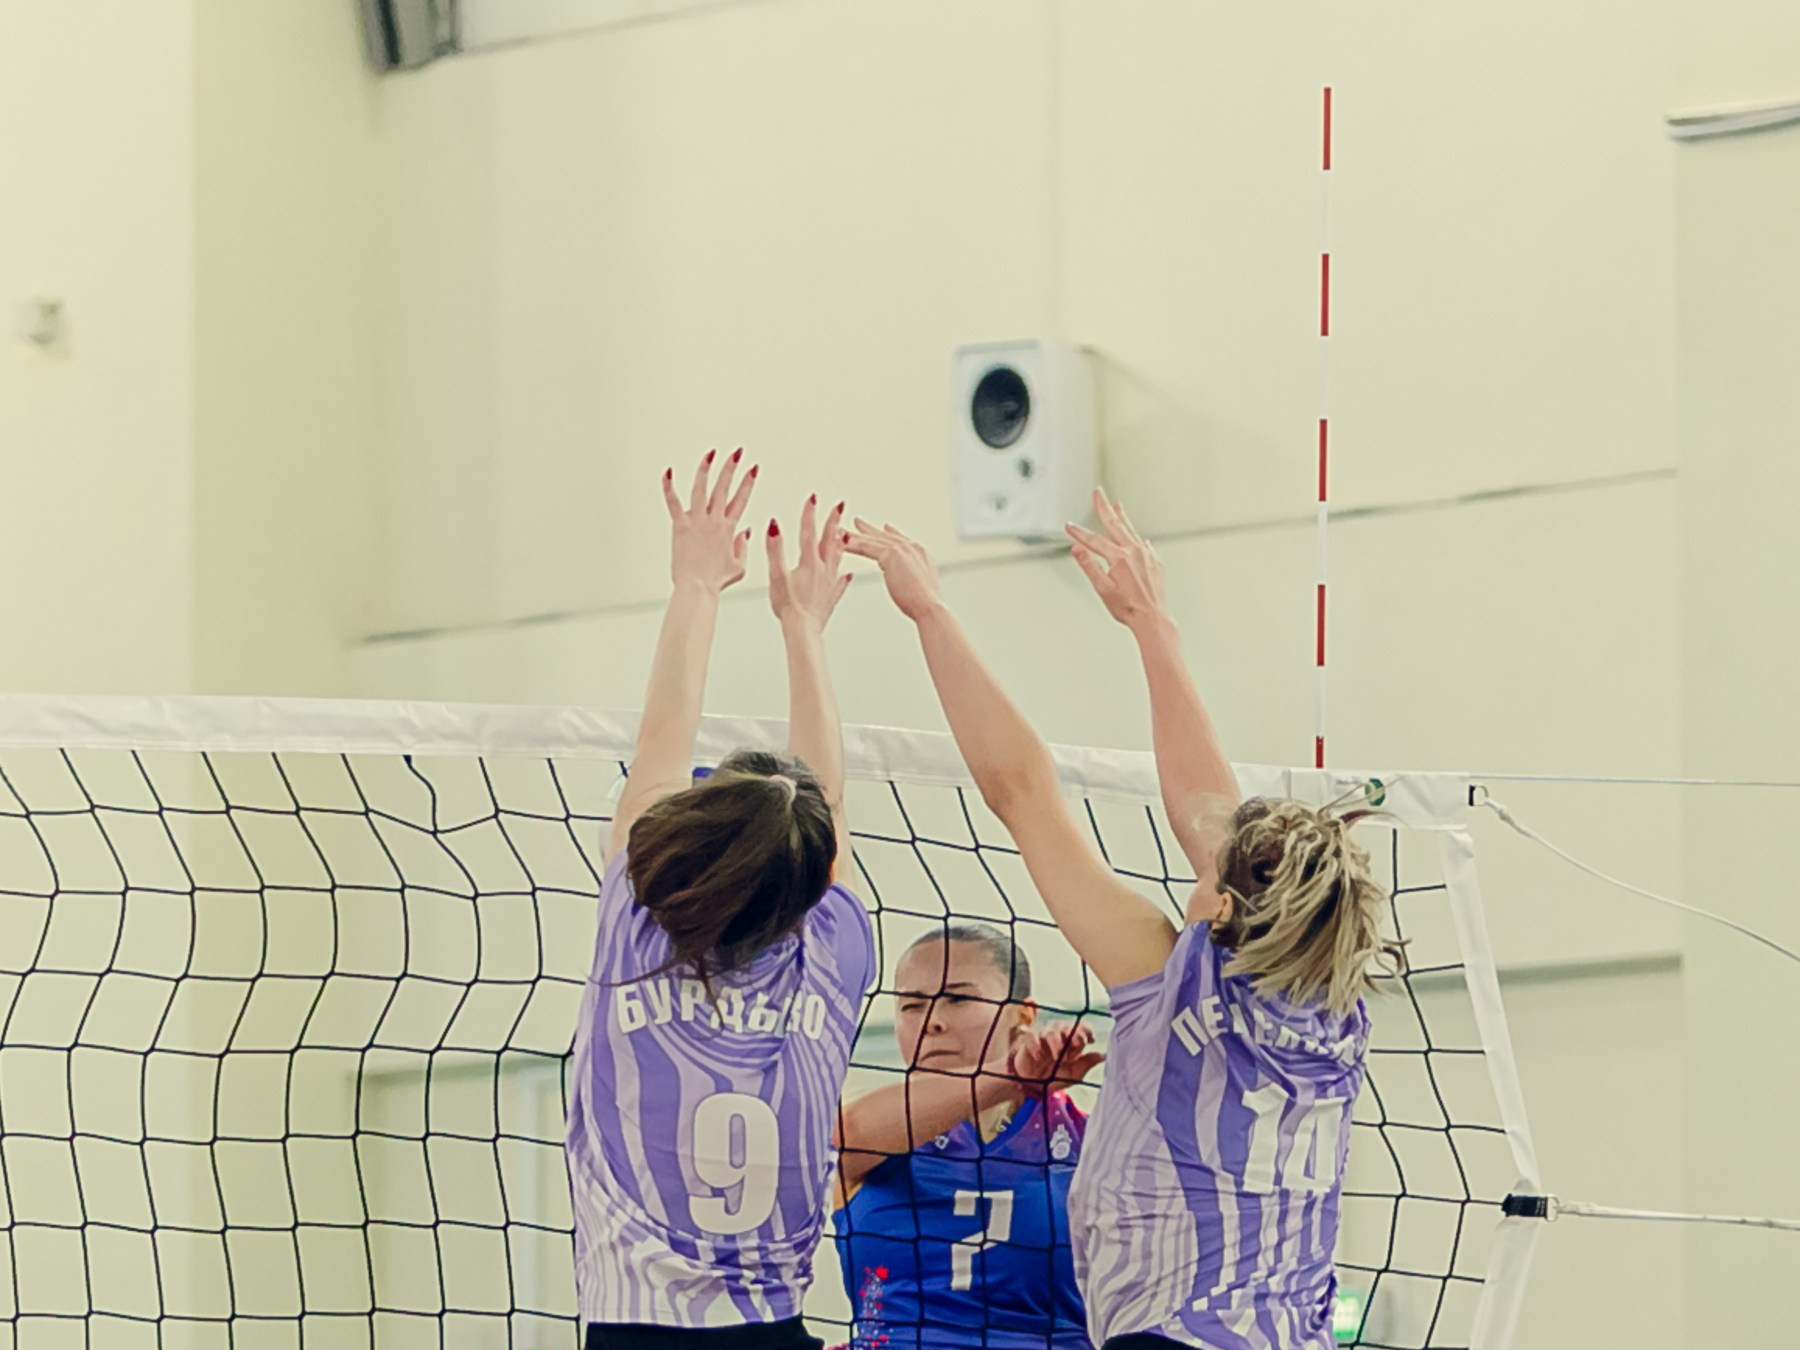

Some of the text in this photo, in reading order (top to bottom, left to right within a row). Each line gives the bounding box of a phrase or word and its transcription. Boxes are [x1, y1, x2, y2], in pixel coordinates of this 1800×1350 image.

[689, 1092, 780, 1234] 9
[1242, 1083, 1348, 1193] 14
[951, 1189, 1014, 1291] 7
